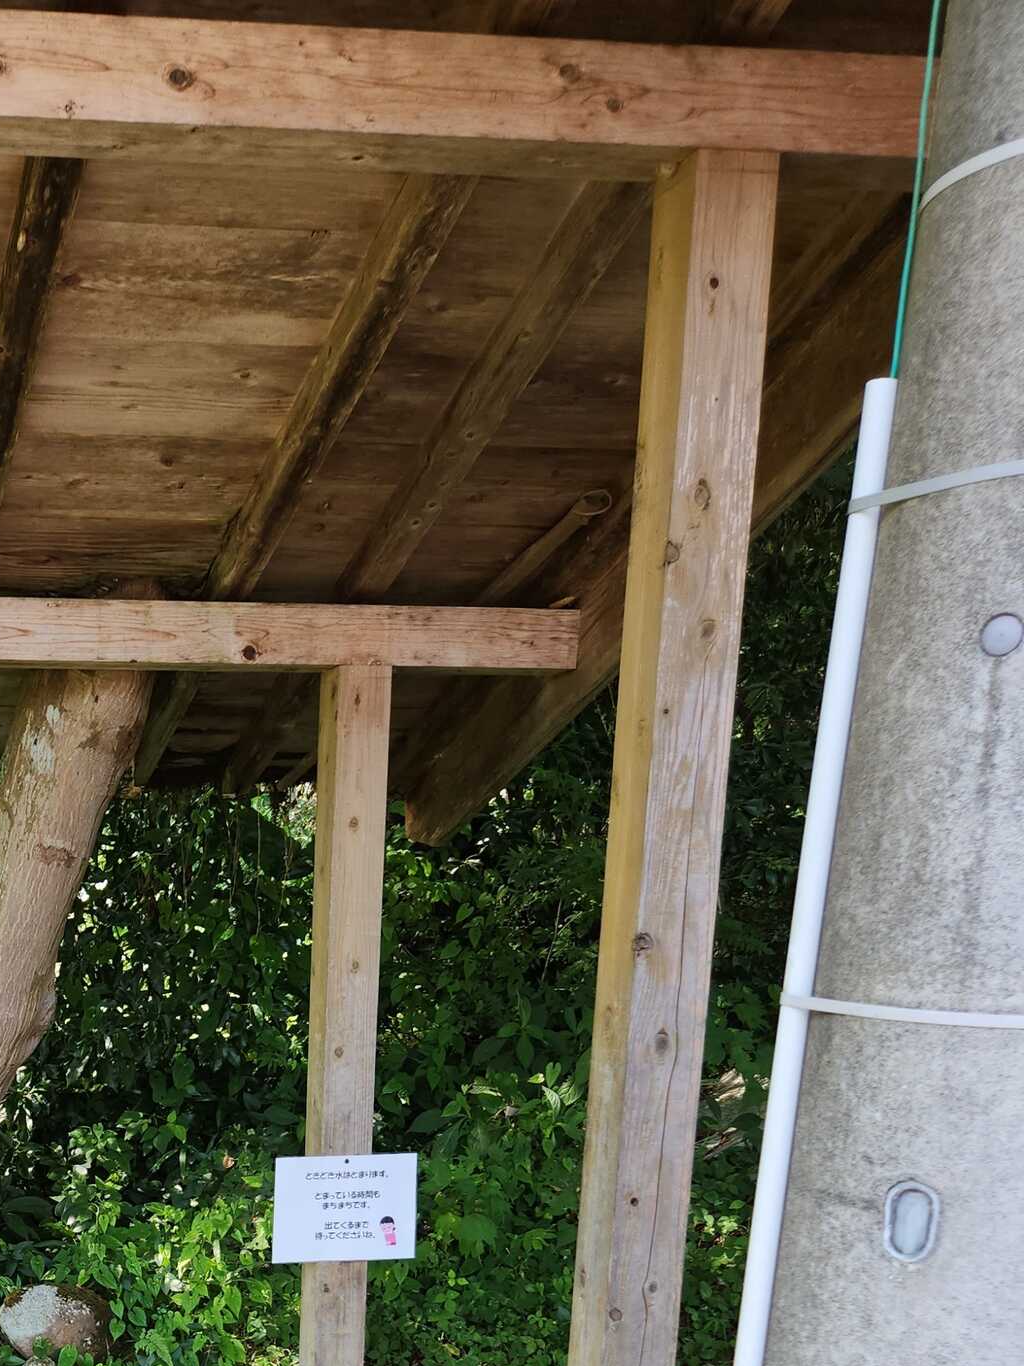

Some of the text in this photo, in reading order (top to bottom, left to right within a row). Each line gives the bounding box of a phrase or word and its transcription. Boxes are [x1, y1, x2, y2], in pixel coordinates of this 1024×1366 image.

[324, 1221, 368, 1230] 出てくるまで
